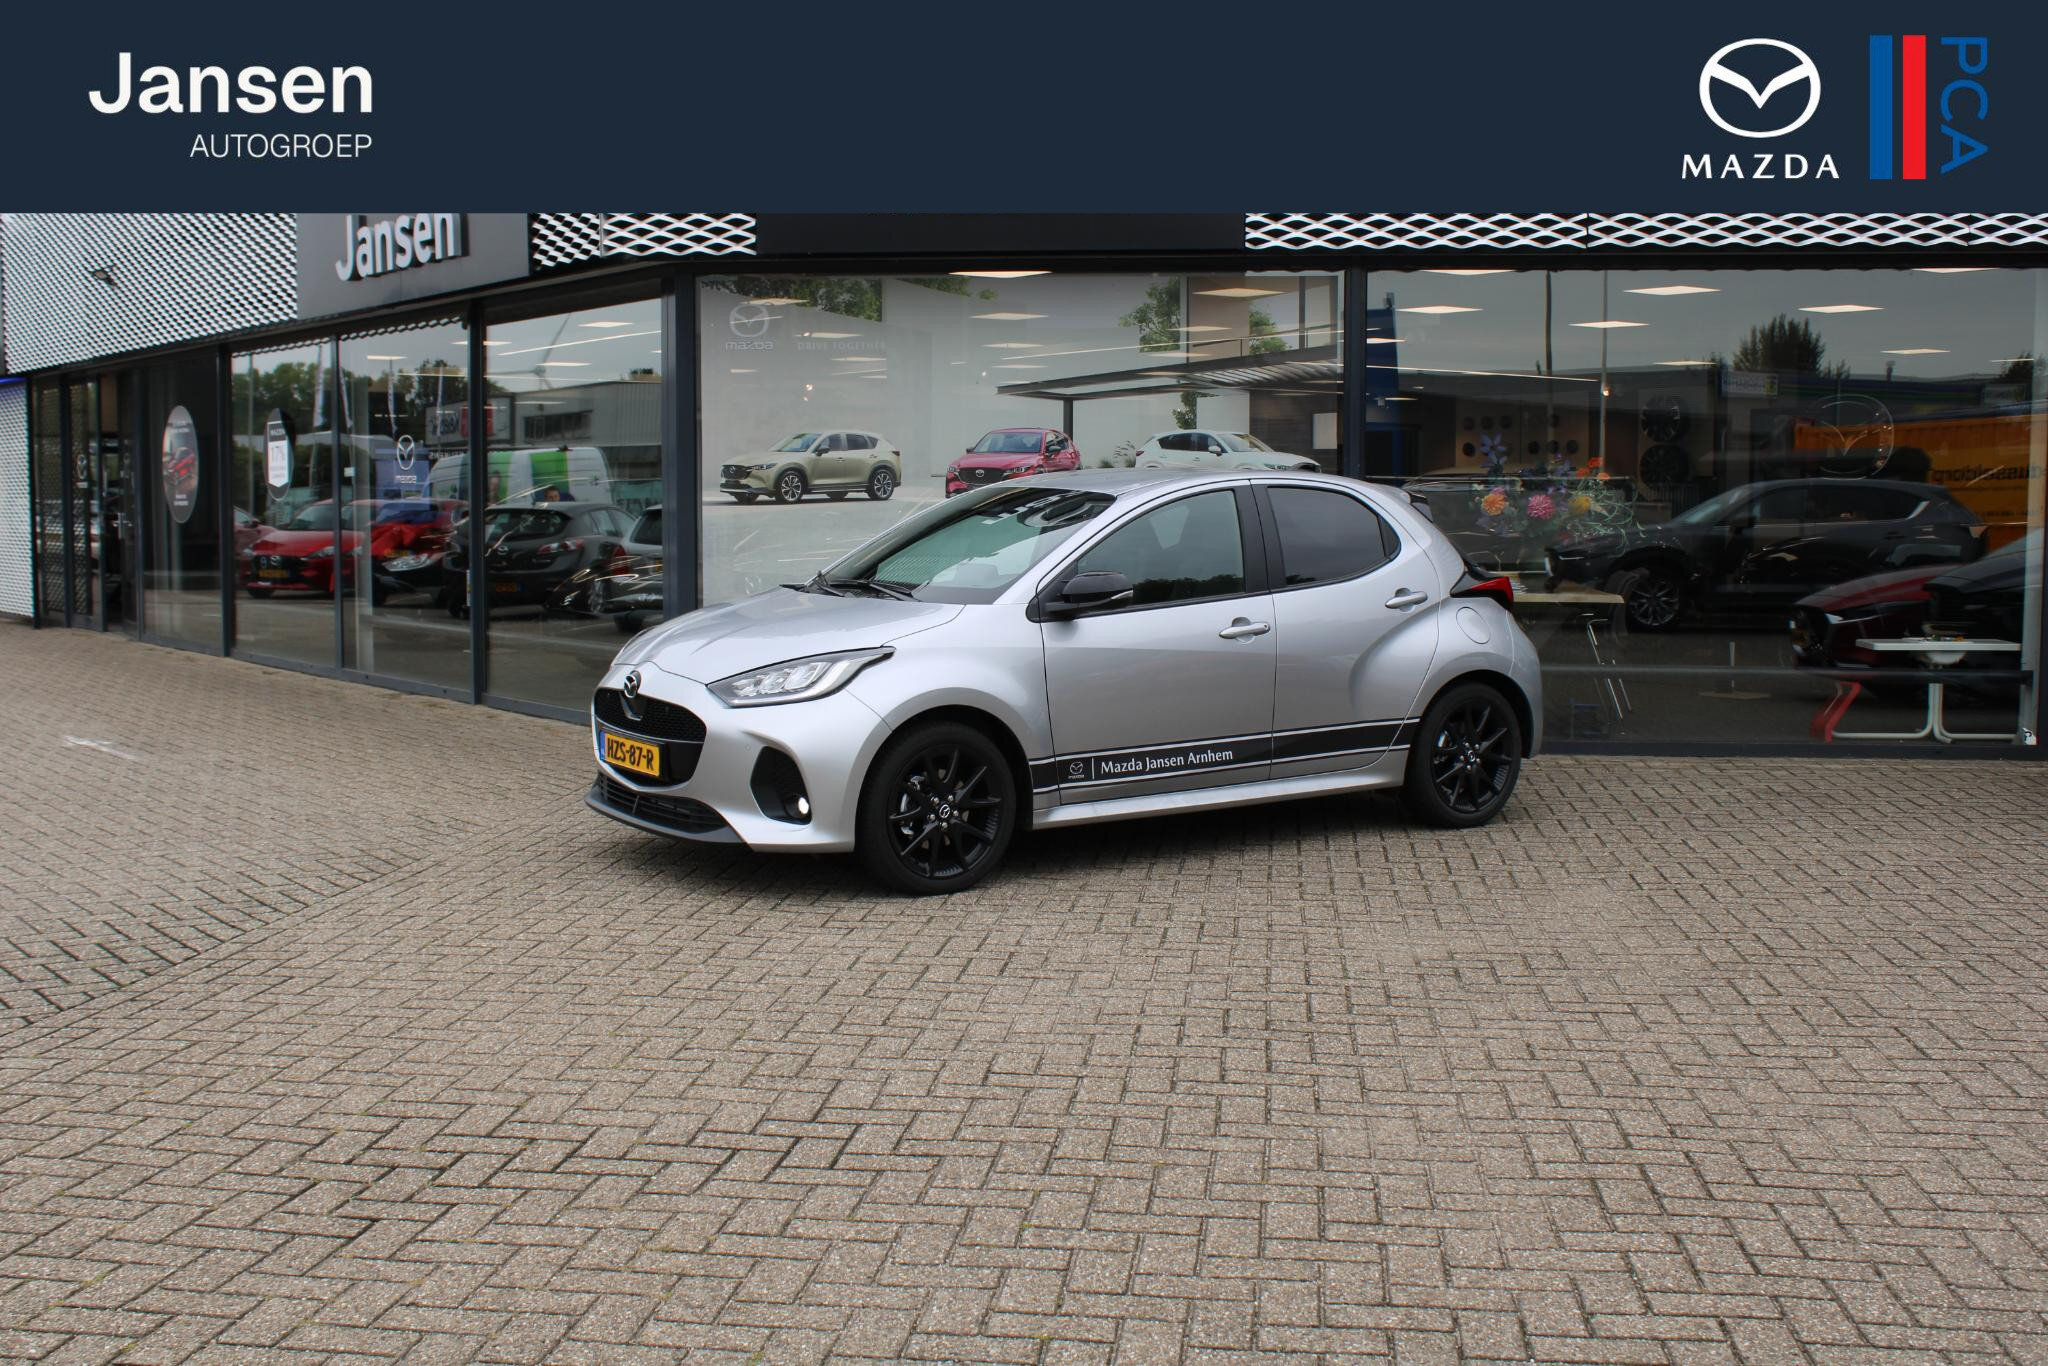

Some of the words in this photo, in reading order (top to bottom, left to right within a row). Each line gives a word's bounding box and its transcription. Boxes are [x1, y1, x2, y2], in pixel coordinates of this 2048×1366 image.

[335, 213, 457, 281] Jansen
[607, 737, 654, 771] HZS-87-R
[1101, 759, 1143, 774] Mazda
[1145, 755, 1185, 771] Jansen
[1187, 750, 1233, 765] Arnhem
